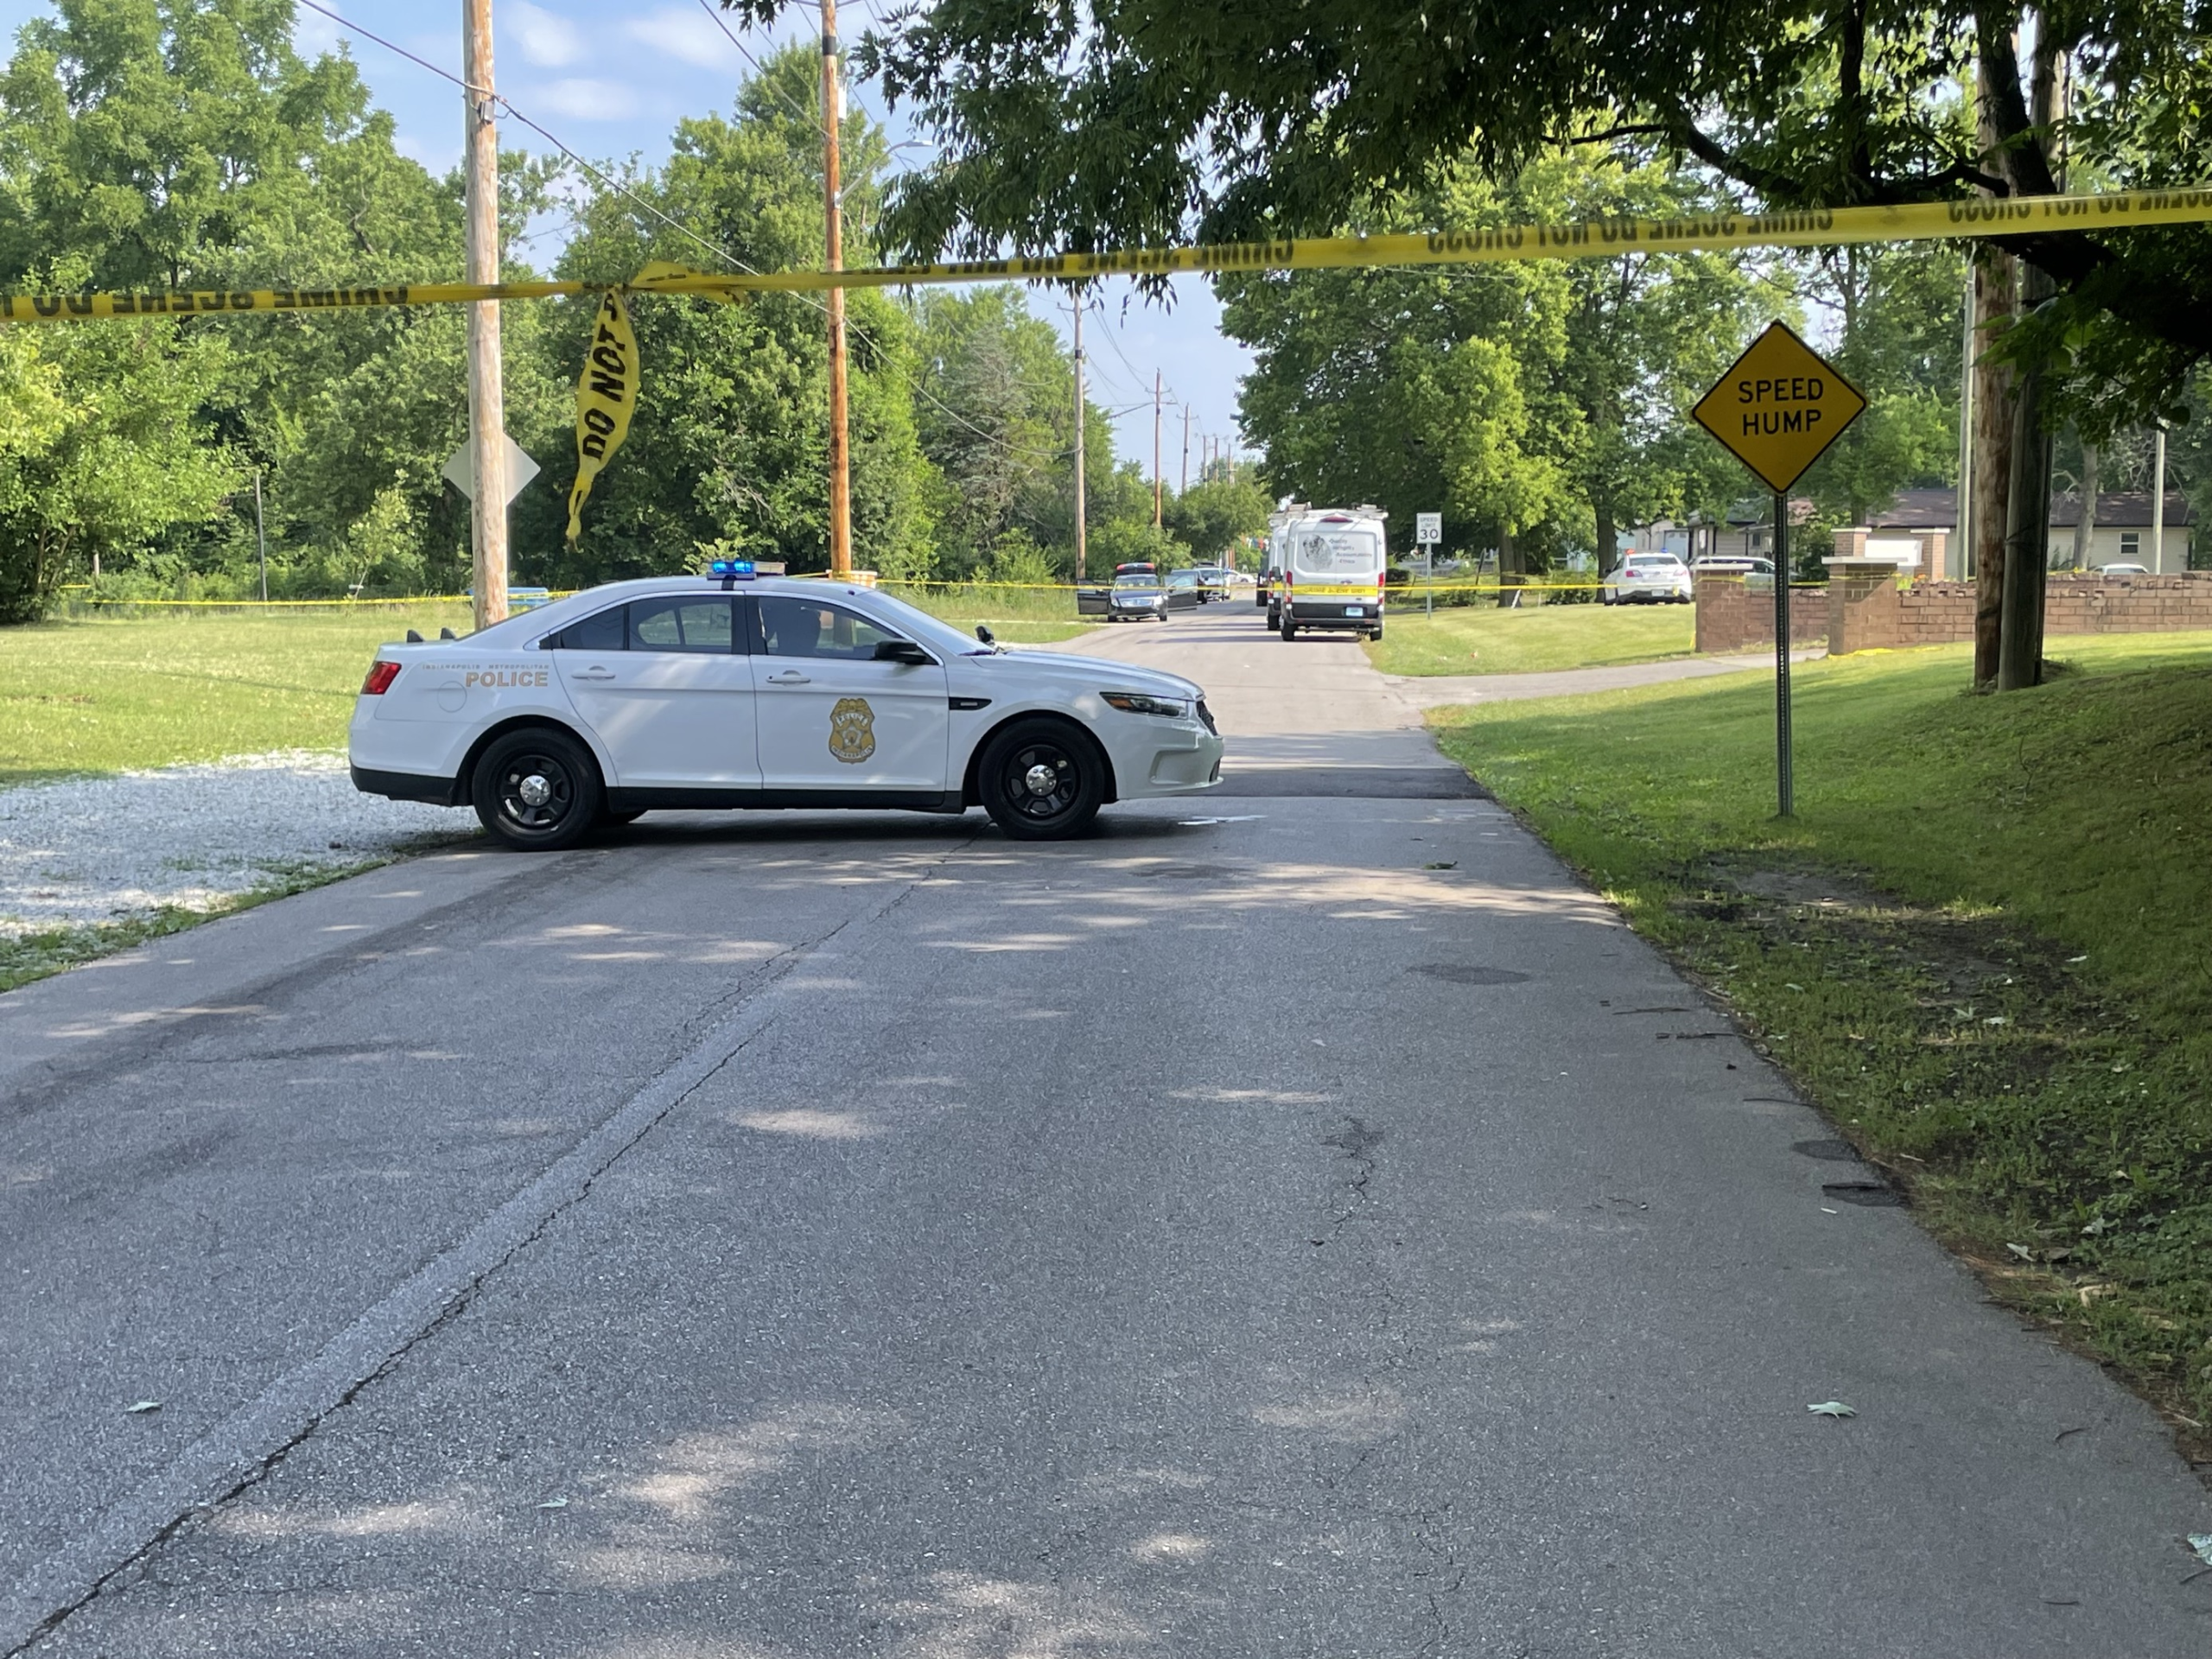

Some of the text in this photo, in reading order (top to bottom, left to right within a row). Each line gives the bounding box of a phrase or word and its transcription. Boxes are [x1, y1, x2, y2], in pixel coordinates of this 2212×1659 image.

[589, 323, 627, 404] NOT
[1738, 378, 1824, 404] SPEED
[582, 407, 616, 461] DO
[1743, 409, 1821, 436] HUMP
[1420, 529, 1439, 540] 30
[466, 671, 549, 687] POLICE
